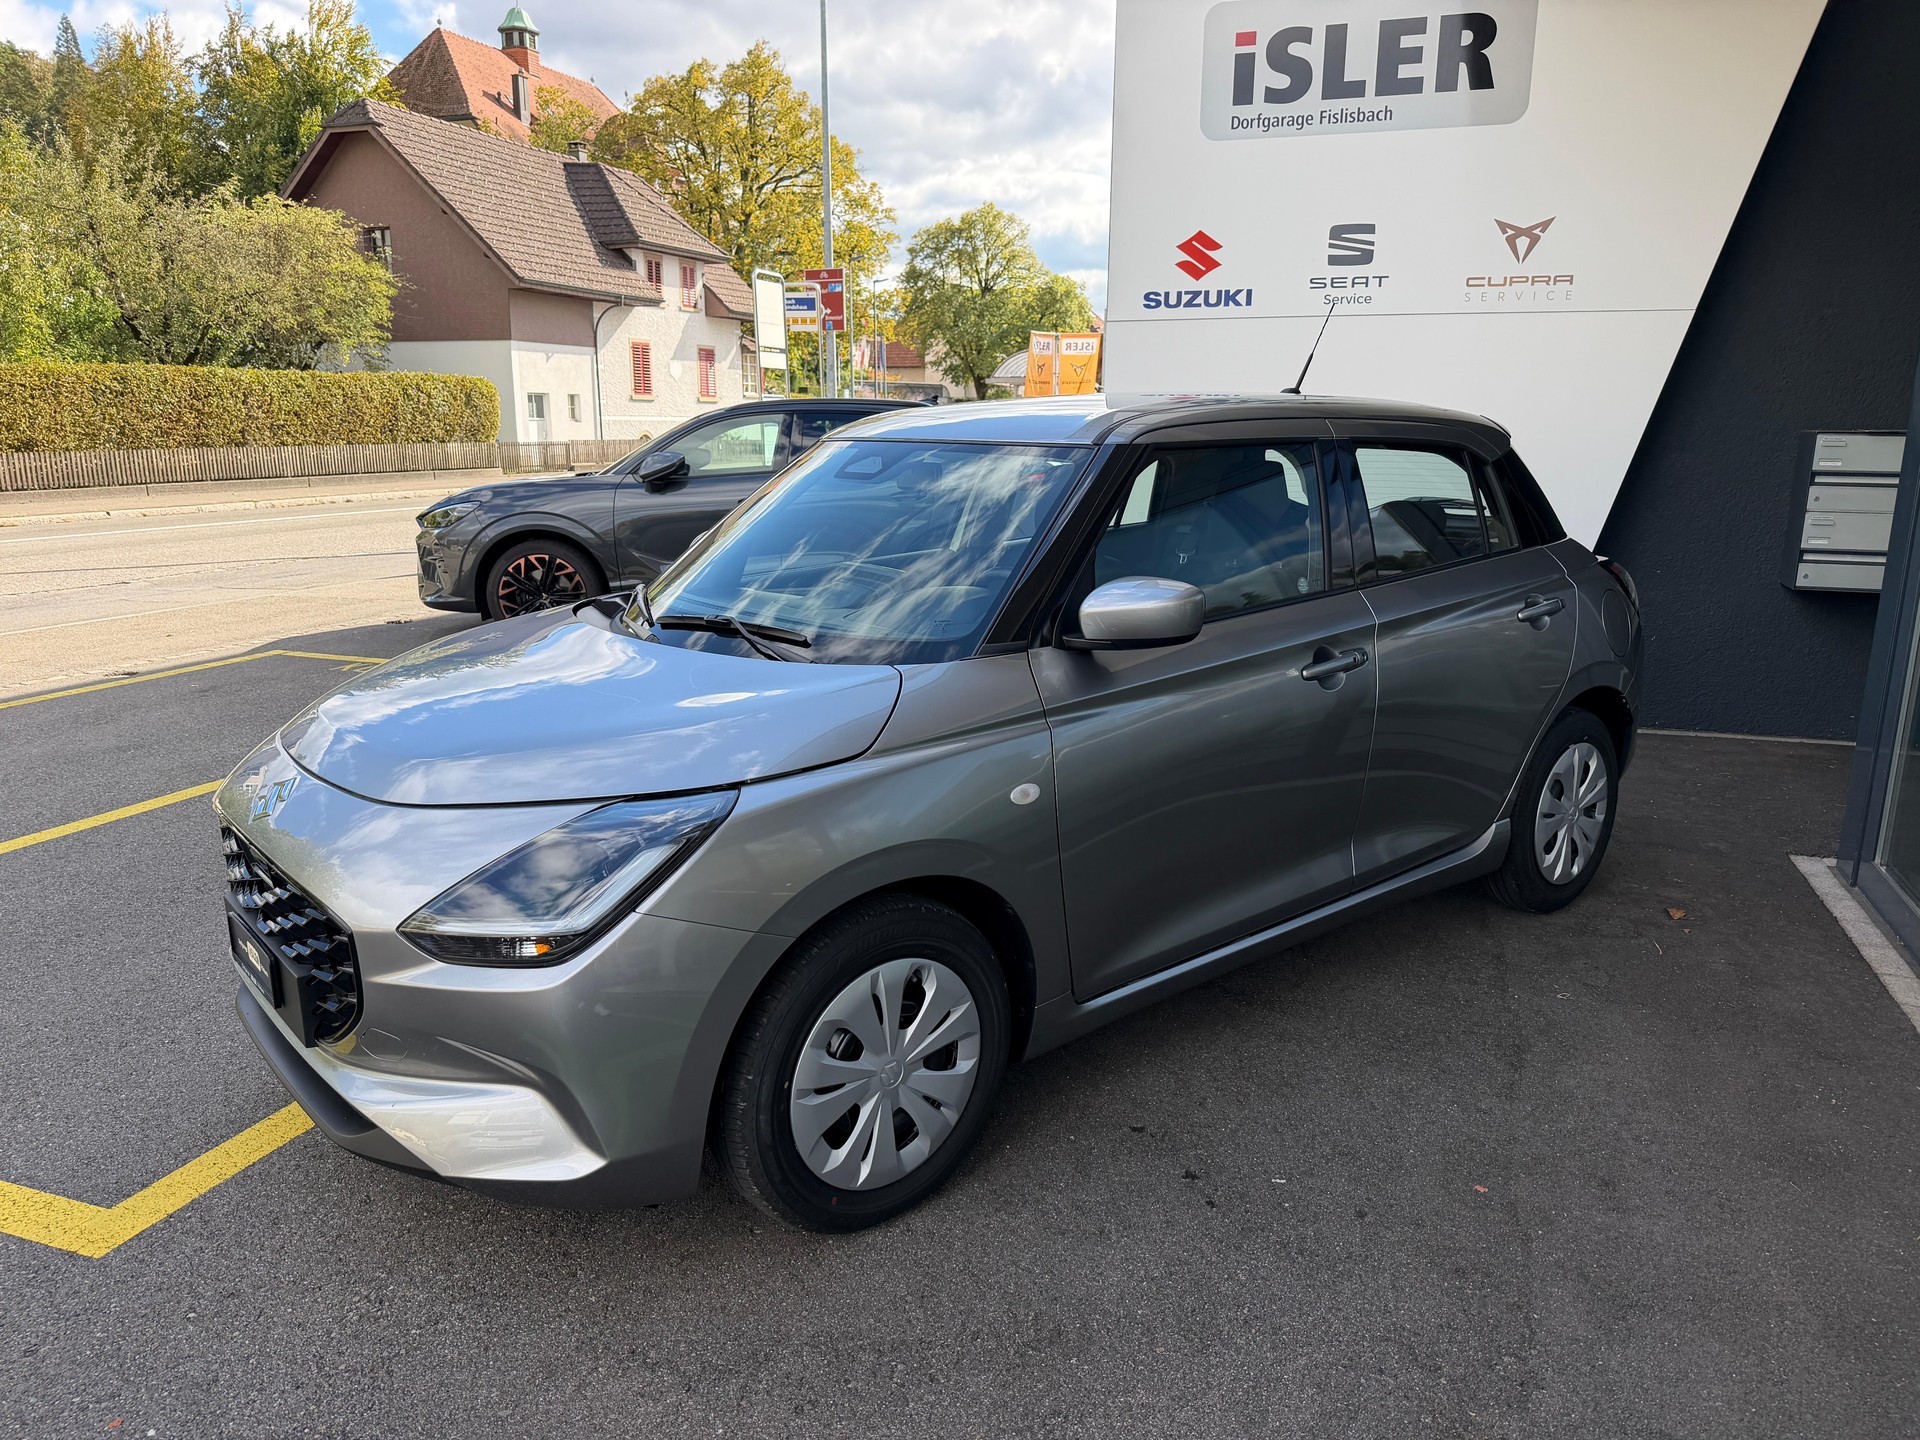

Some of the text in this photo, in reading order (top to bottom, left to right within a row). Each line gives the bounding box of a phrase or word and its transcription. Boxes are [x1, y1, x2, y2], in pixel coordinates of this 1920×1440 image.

[1230, 104, 1394, 133] Dorfgarage Fislisbach
[1309, 275, 1390, 290] SEAT
[1465, 274, 1575, 288] CUPRA
[1142, 288, 1253, 310] SUZUKI
[1323, 293, 1373, 305] Service
[1464, 290, 1574, 303] SERVICE
